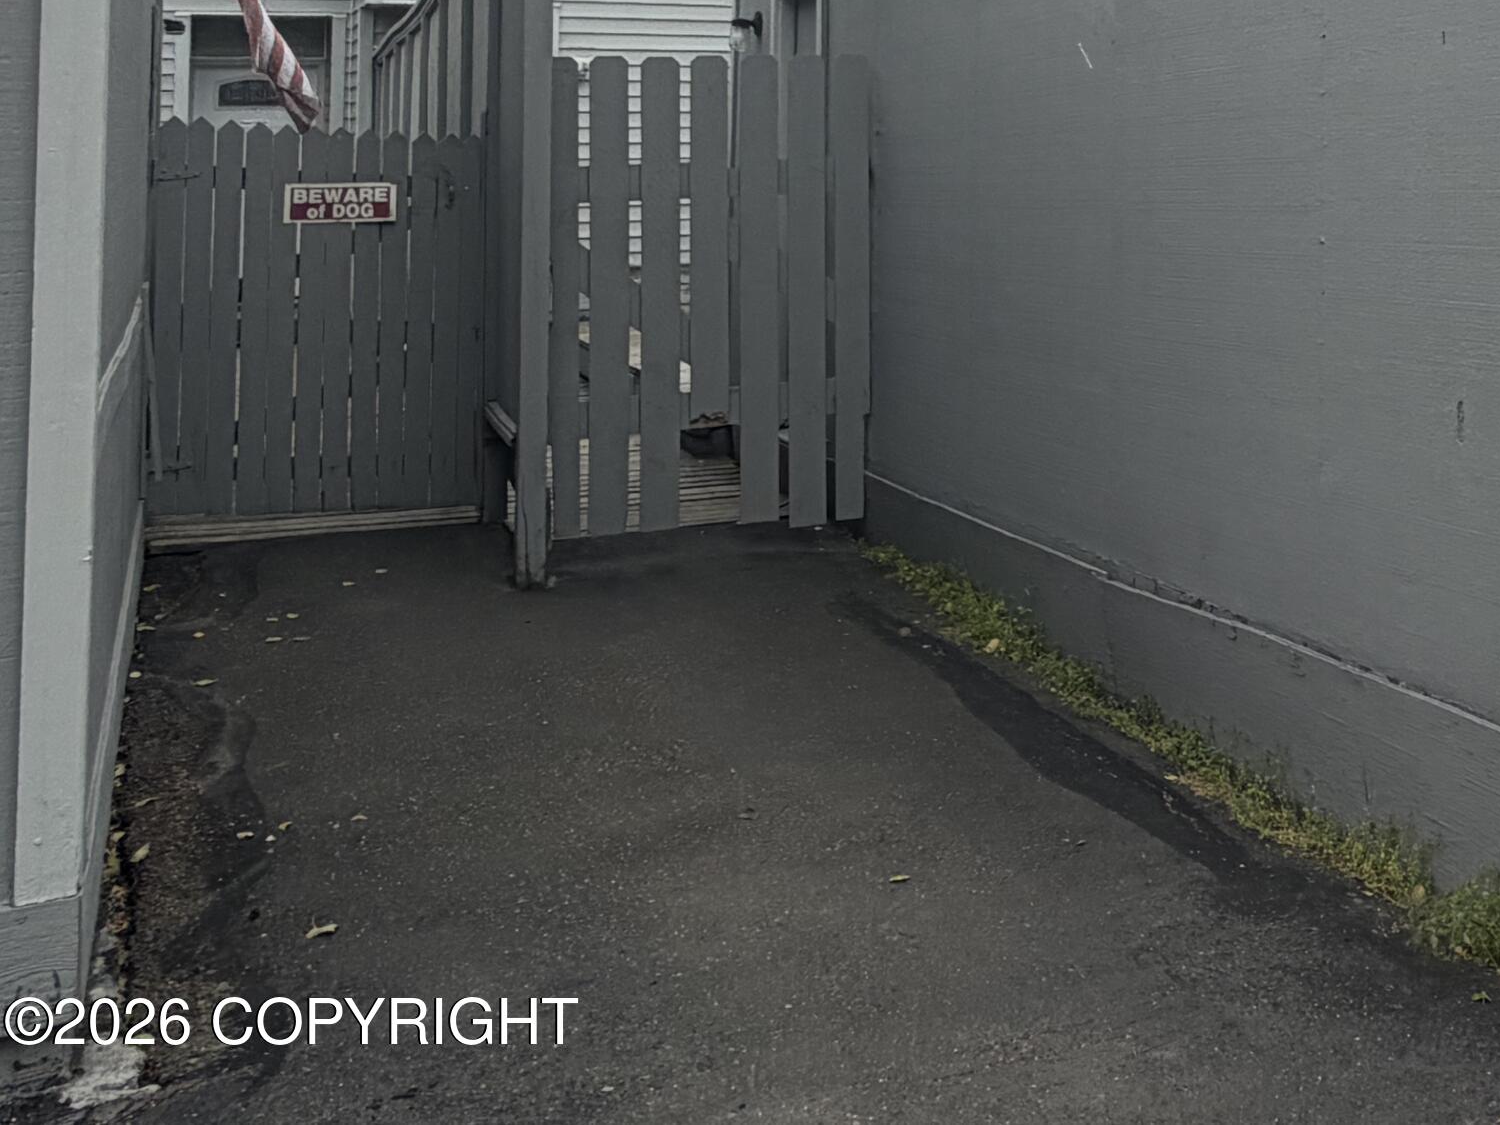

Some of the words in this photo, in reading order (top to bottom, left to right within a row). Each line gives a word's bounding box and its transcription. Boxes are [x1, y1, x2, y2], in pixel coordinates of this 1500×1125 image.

[293, 188, 388, 204] BEWARE
[306, 205, 326, 219] of
[332, 203, 374, 218] DOG
